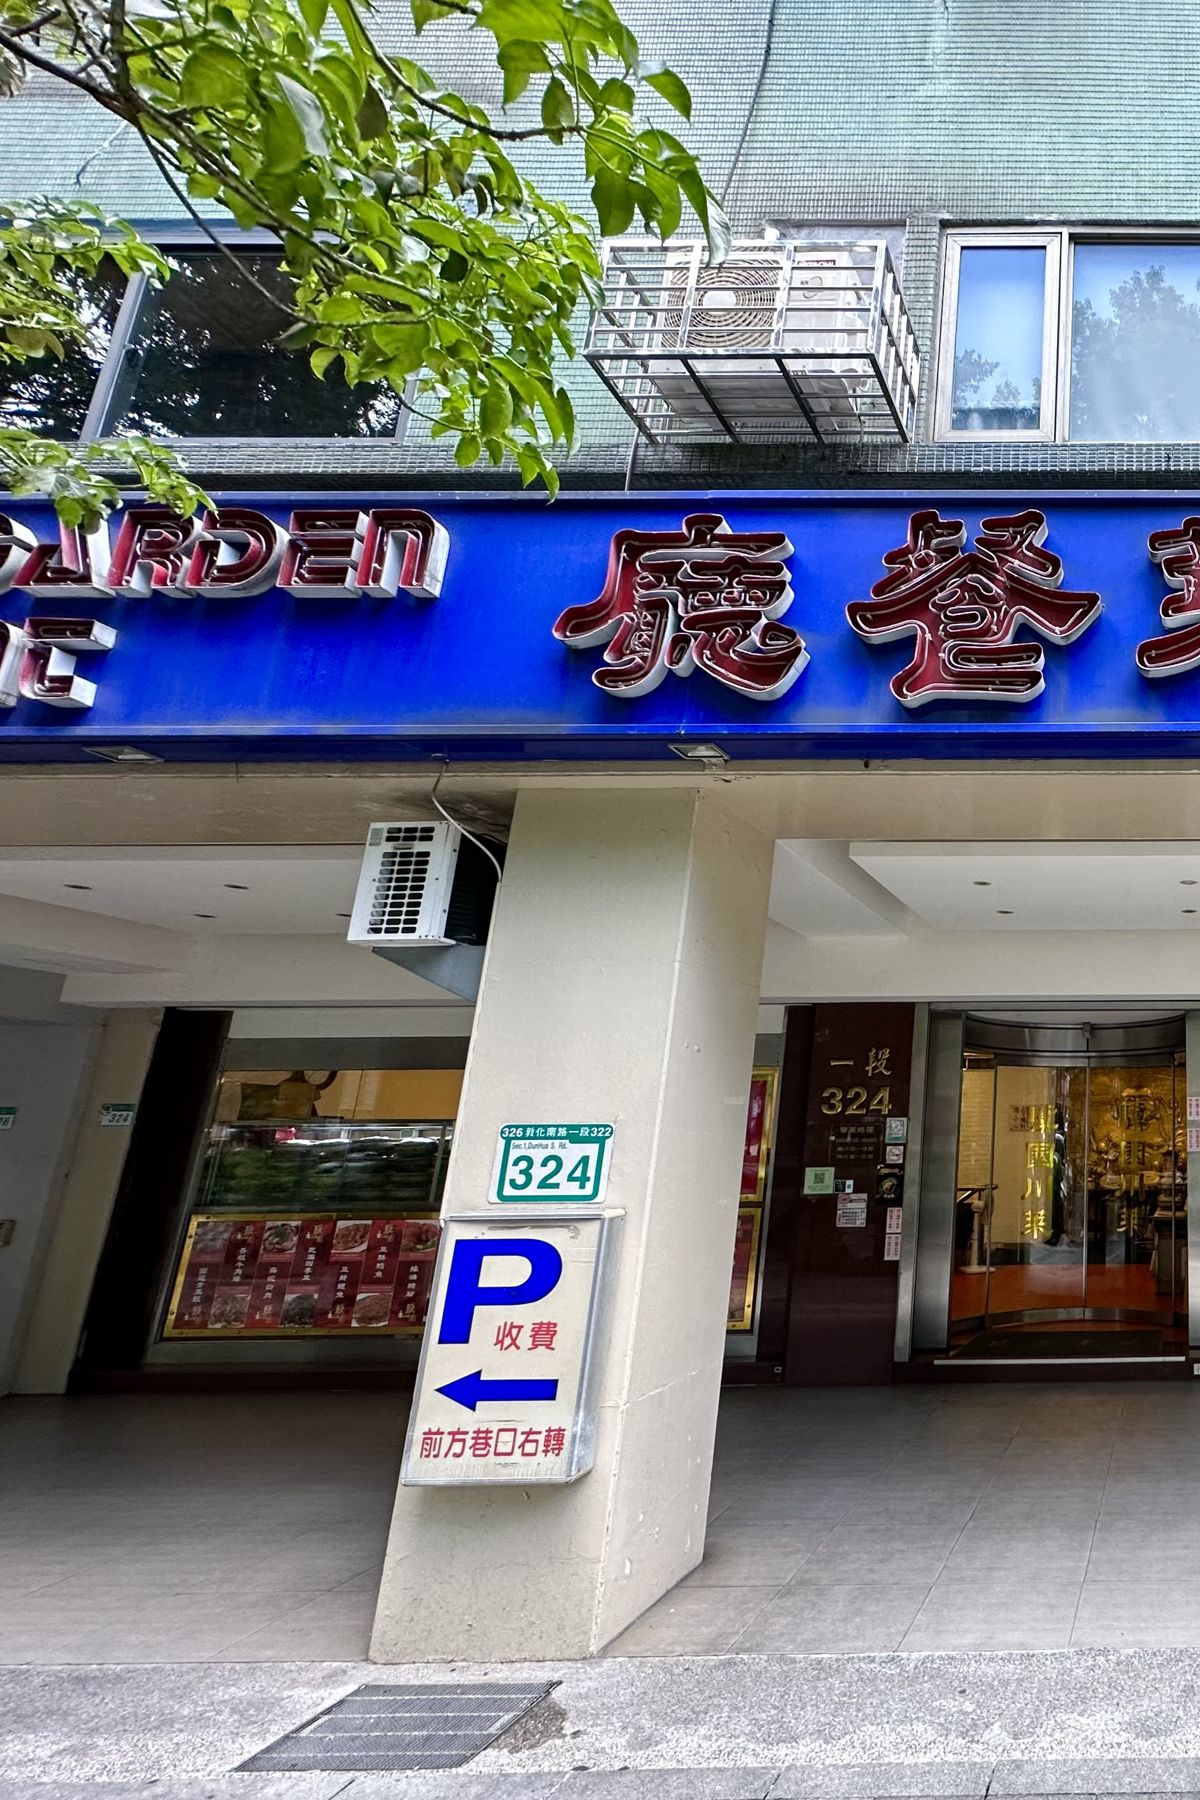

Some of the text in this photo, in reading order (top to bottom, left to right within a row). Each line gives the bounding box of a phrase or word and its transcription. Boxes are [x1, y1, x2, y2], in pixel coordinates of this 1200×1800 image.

[829, 1046, 893, 1078] 一段
[820, 1086, 893, 1116] 324
[502, 1127, 611, 1137] 326 敦化南路一段 322
[508, 1154, 591, 1191] 324
[437, 1238, 563, 1345] P
[492, 1320, 559, 1352] 收費
[419, 1426, 568, 1460] 前方巷口右轉
